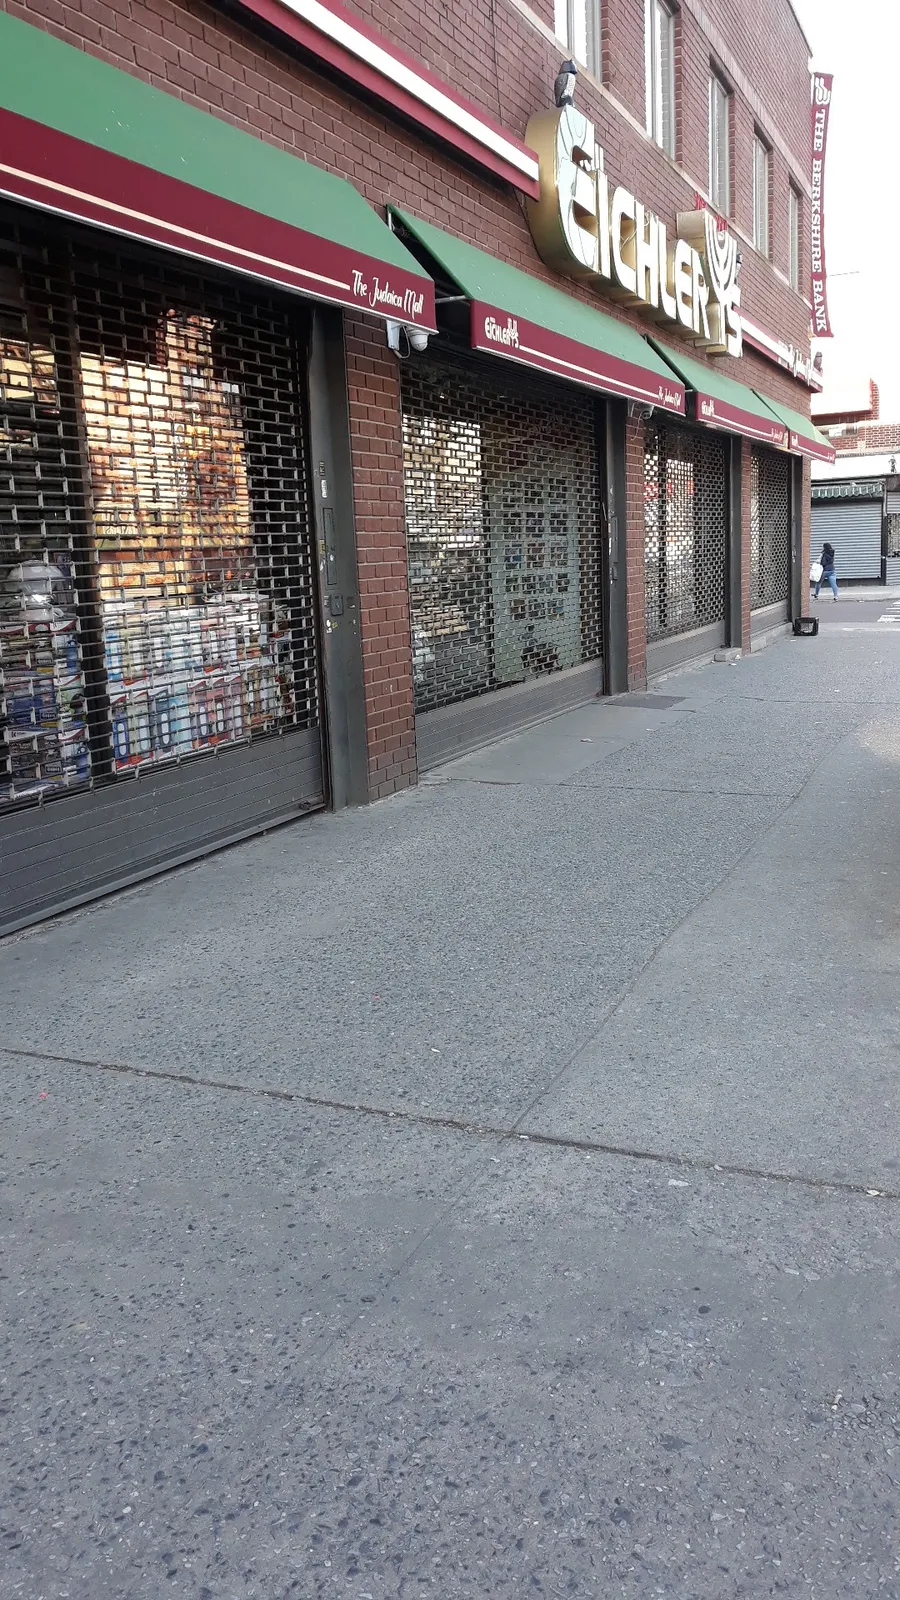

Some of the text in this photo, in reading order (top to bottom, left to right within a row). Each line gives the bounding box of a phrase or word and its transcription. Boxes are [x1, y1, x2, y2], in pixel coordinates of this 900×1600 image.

[811, 109, 828, 332] THE BERKSHIRE BANK
[351, 269, 424, 321] The Judaica Mall
